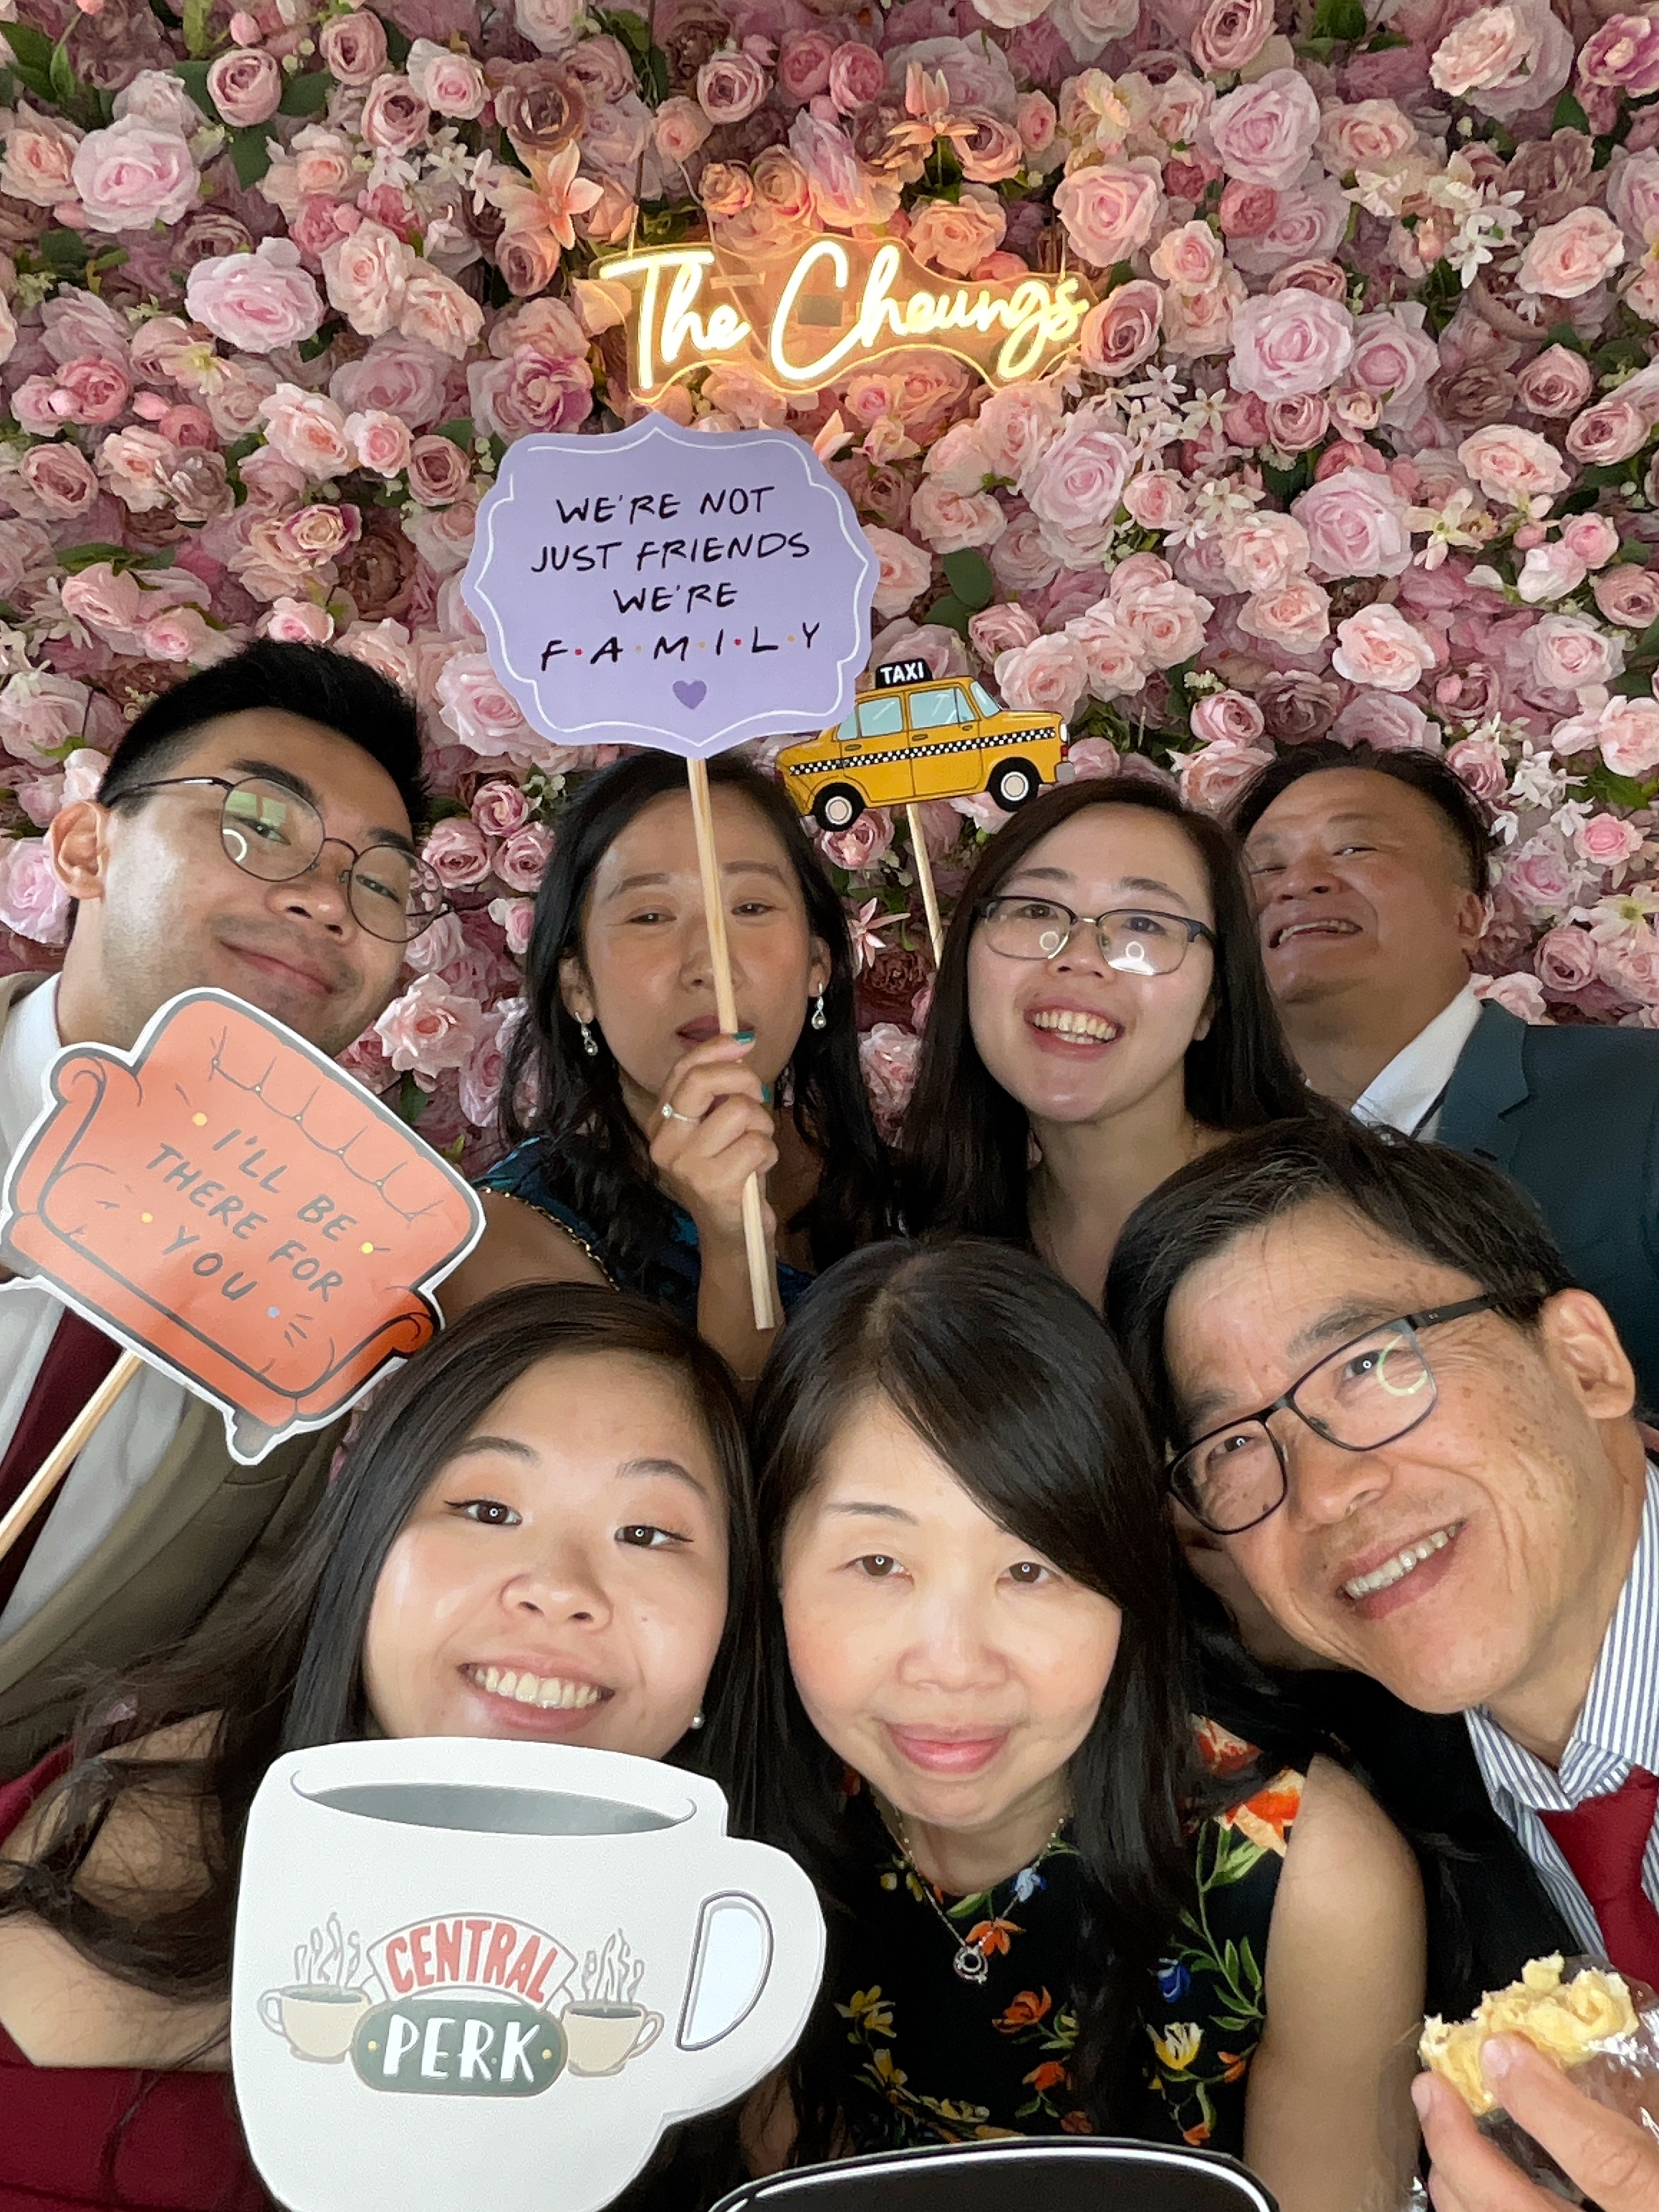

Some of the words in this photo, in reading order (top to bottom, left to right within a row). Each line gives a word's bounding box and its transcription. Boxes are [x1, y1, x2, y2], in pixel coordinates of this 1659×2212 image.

[600, 249, 751, 390] The
[769, 240, 1089, 381] Cheungs
[555, 492, 681, 525] WE'RE
[699, 486, 775, 516] NOT
[531, 541, 622, 573] JUST
[636, 532, 810, 571] FRIENDS
[612, 582, 738, 614] WE'RE
[880, 661, 925, 686] TAXI
[145, 1141, 268, 1241] THERE
[268, 1239, 345, 1303] FOR
[211, 1128, 288, 1195] I'LL
[297, 1193, 358, 1243] BE
[161, 1224, 259, 1302] YOU
[385, 1919, 559, 2003] CENTRAL
[382, 2014, 541, 2084] PERK
